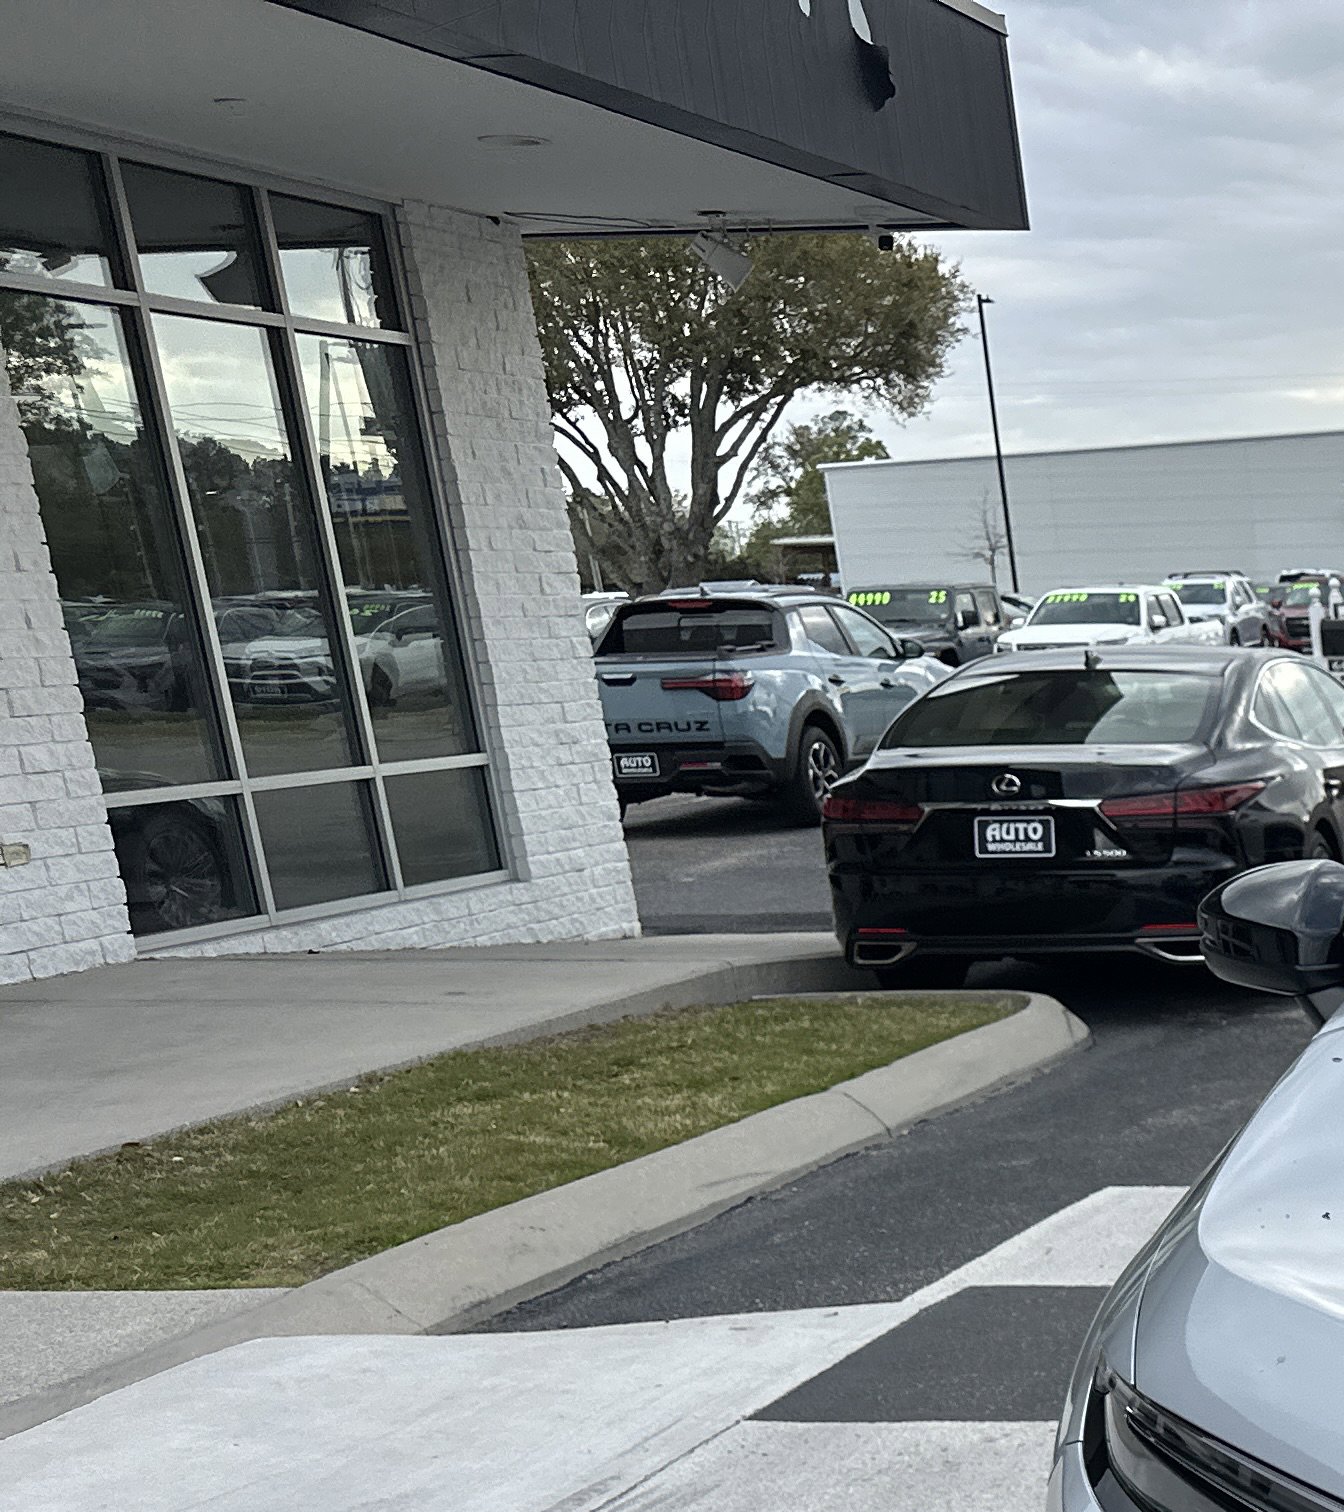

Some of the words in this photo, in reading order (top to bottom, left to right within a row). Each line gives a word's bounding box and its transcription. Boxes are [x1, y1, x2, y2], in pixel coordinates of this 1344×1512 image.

[638, 721, 710, 733] CRUZ
[620, 756, 652, 768] AUTO
[986, 822, 1043, 842] AUTO
